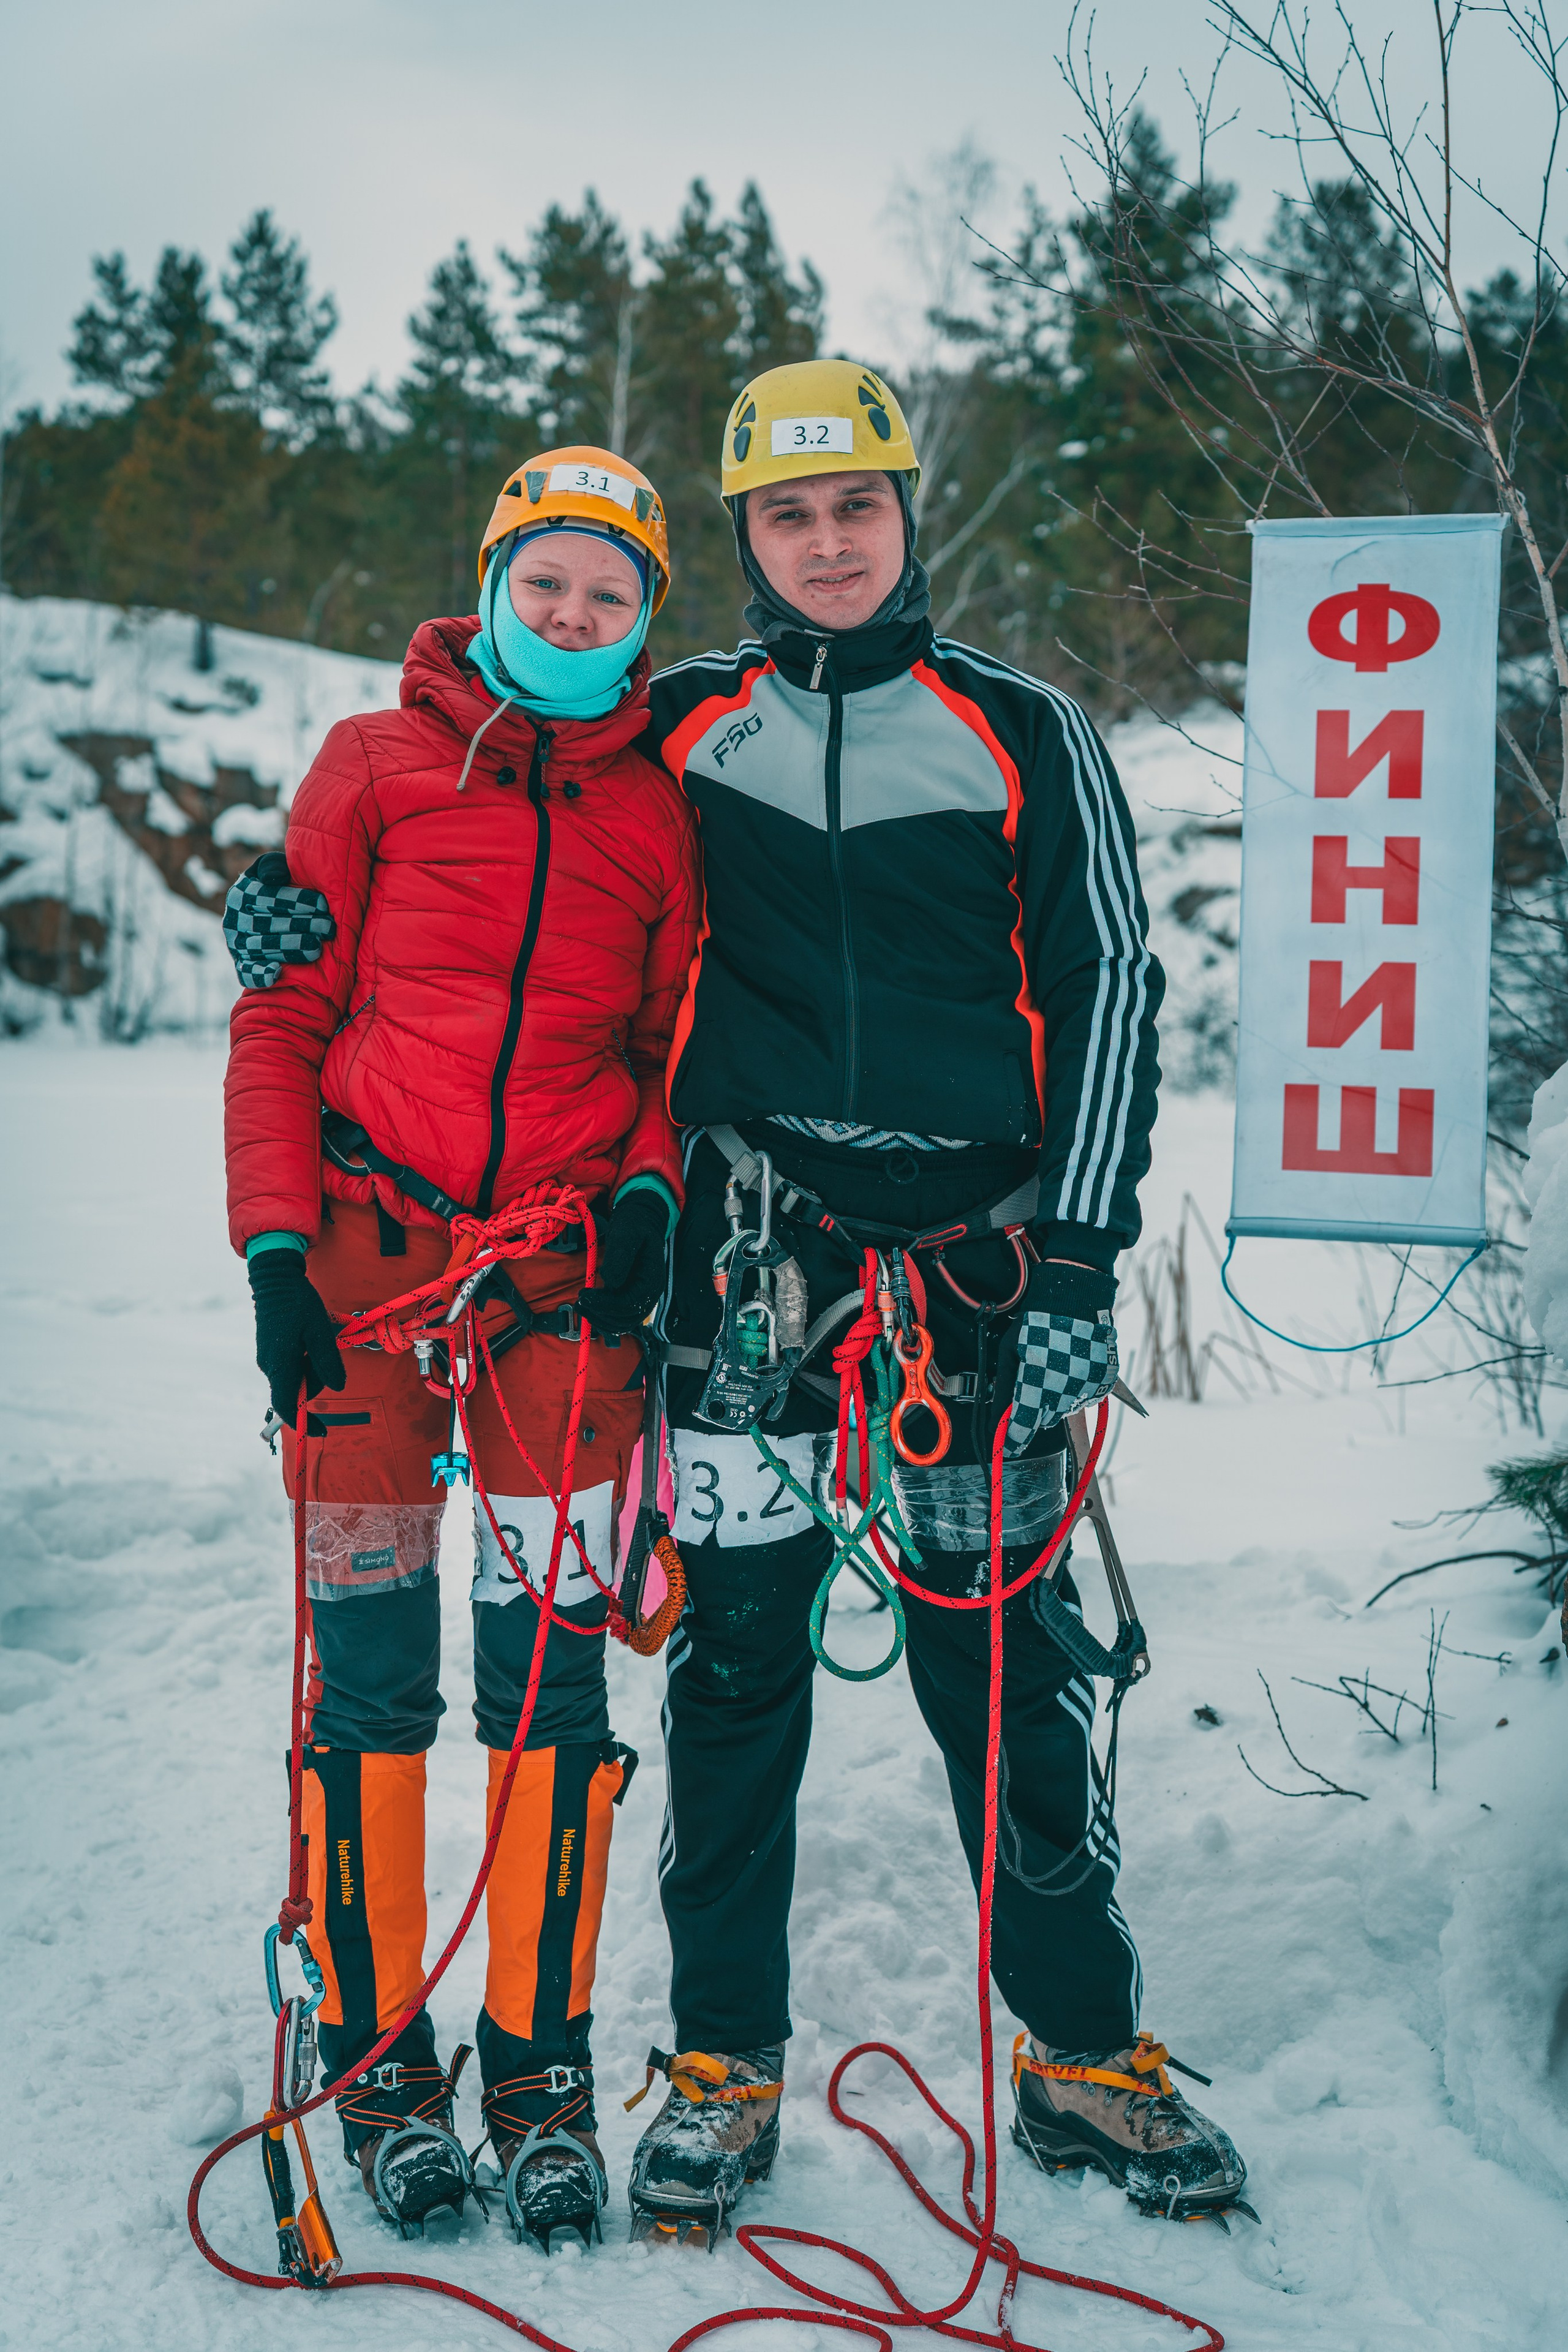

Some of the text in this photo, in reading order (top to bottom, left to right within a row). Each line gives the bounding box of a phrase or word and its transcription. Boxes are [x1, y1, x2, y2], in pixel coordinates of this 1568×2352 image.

[794, 425, 829, 445] 3.2
[576, 471, 609, 492] 3.1
[1281, 583, 1441, 1177] ФИНИШ
[691, 1458, 794, 1522] 3.2
[364, 1555, 389, 1564] SIMOND
[337, 1839, 354, 1905] Naturehike
[557, 1828, 576, 1897] Naturehike
